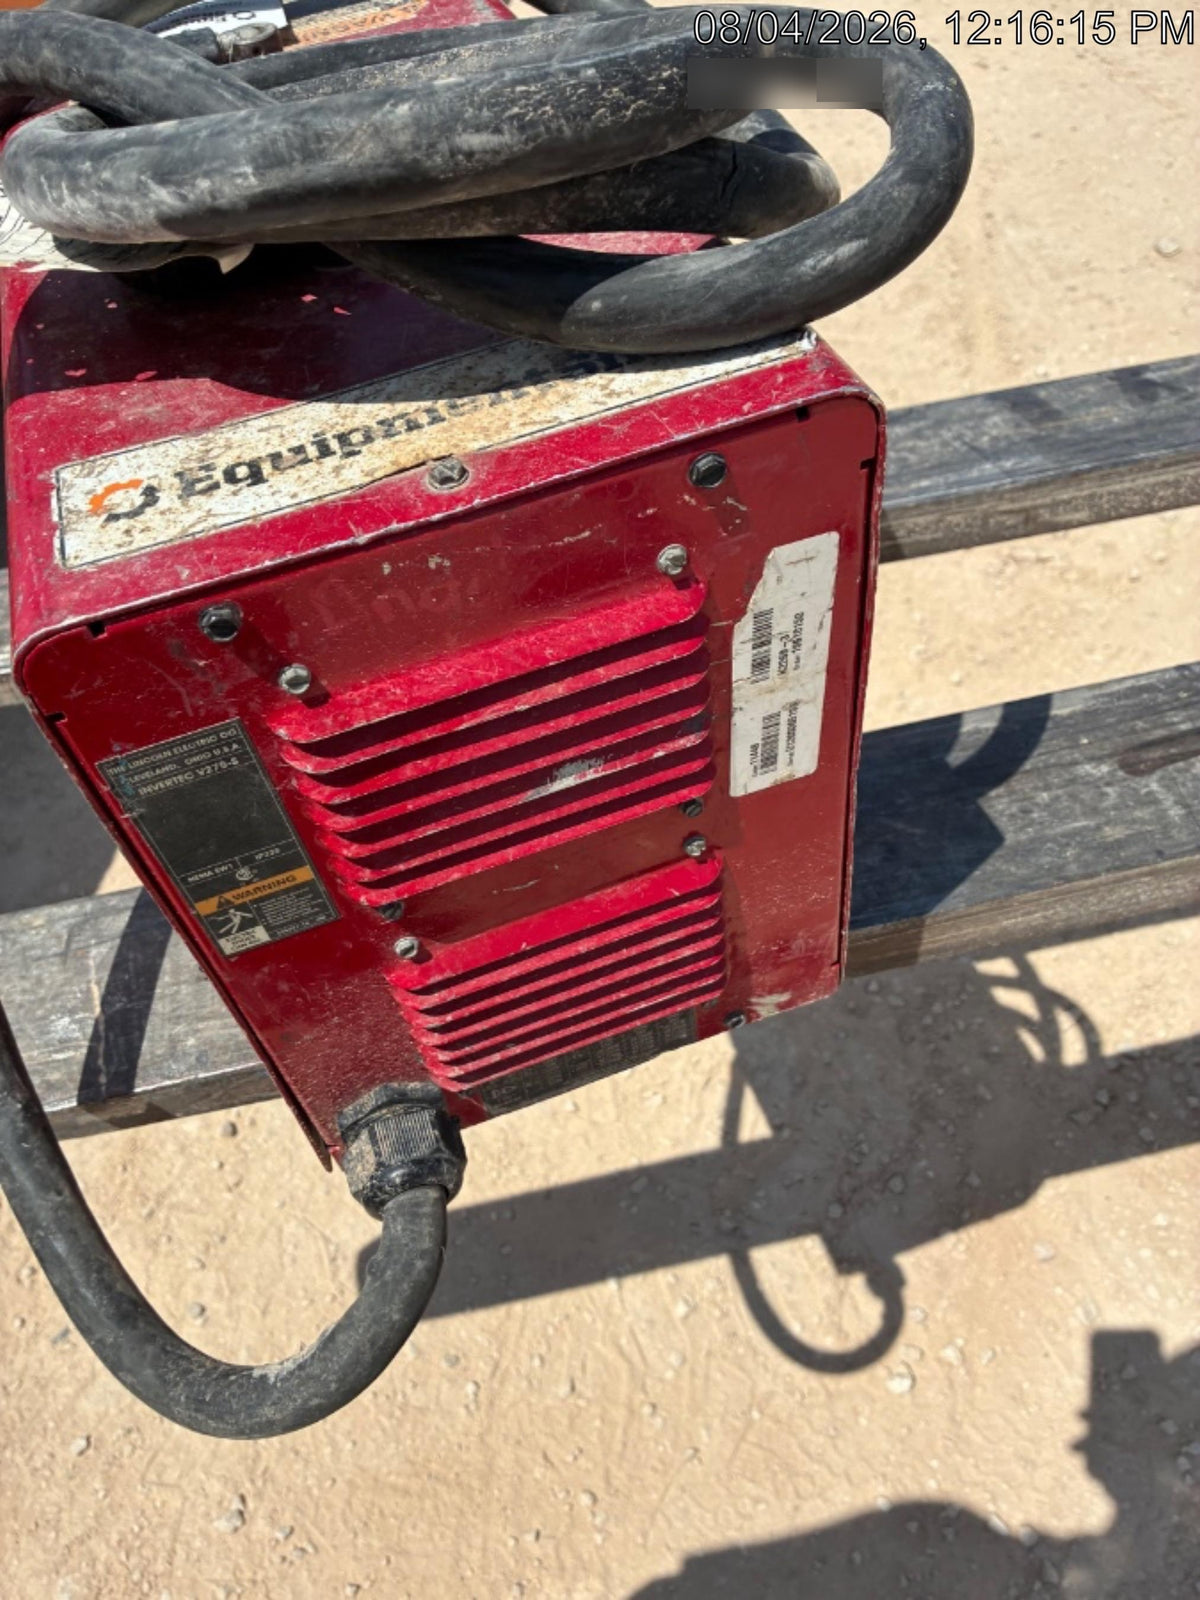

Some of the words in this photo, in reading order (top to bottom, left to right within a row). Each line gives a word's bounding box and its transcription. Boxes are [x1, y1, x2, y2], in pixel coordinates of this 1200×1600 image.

[127, 750, 172, 769] LINCOLN
[172, 735, 218, 755] ELECTRIC
[138, 771, 195, 795] INVERTEC
[232, 874, 297, 902] WARNING
